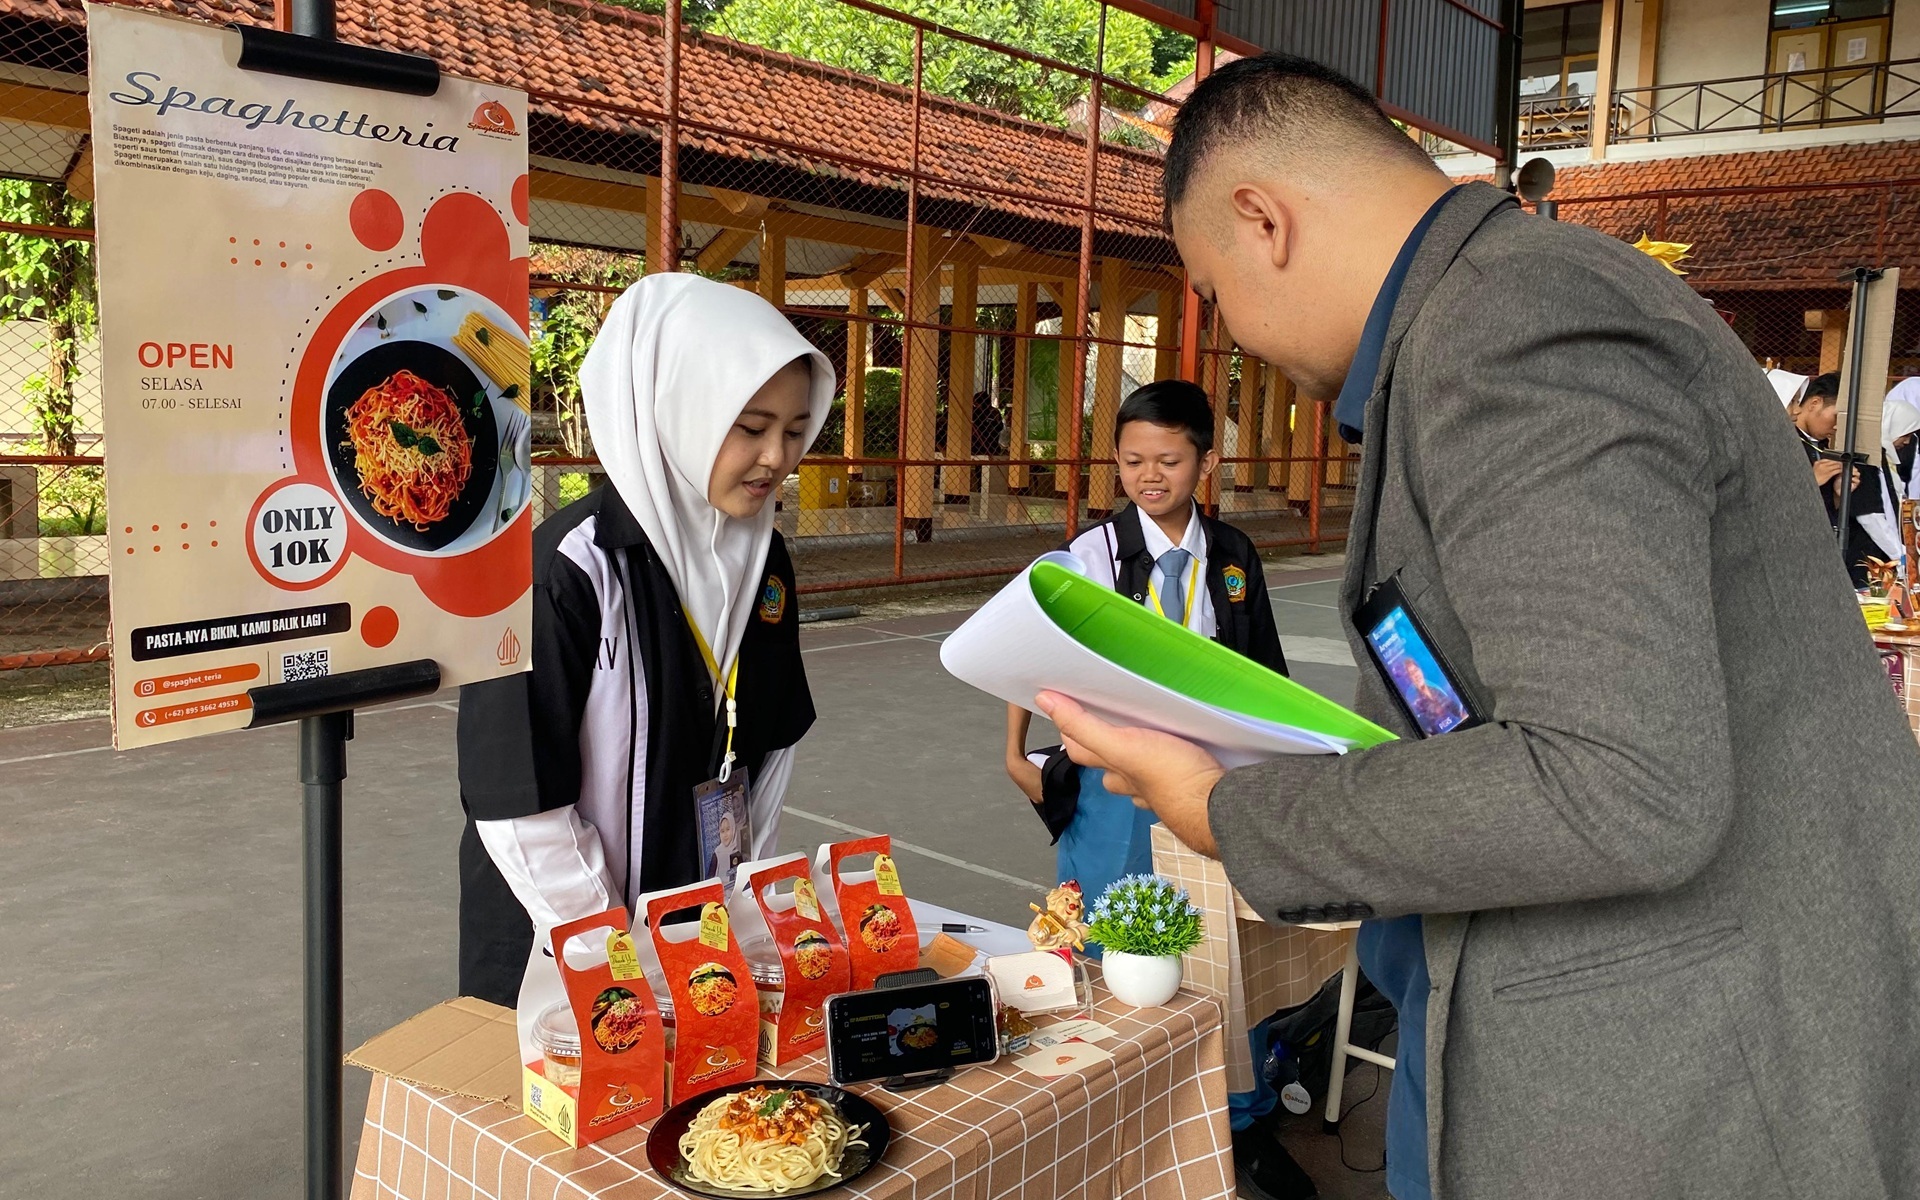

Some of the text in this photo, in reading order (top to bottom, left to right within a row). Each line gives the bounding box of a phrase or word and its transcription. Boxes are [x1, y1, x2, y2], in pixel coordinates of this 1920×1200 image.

[109, 71, 459, 154] Spaghetteria
[138, 341, 233, 369] OPEN
[141, 377, 203, 391] SELASA
[142, 398, 177, 409] 07.00
[188, 397, 242, 409] SELESAI
[262, 506, 336, 534] ONLY
[269, 538, 331, 568] 10K
[146, 629, 208, 650] PASTA-NYA
[210, 625, 240, 641] BIKIN,
[241, 620, 270, 637] KAMU
[272, 616, 299, 633] BALIK
[301, 613, 321, 629] LAGI
[163, 673, 222, 689] @spaghet_teria
[164, 699, 239, 720] (+62) 895 3662 49539
[687, 1058, 747, 1085] Spaghetteria
[589, 1096, 653, 1127] Spaghetteria
